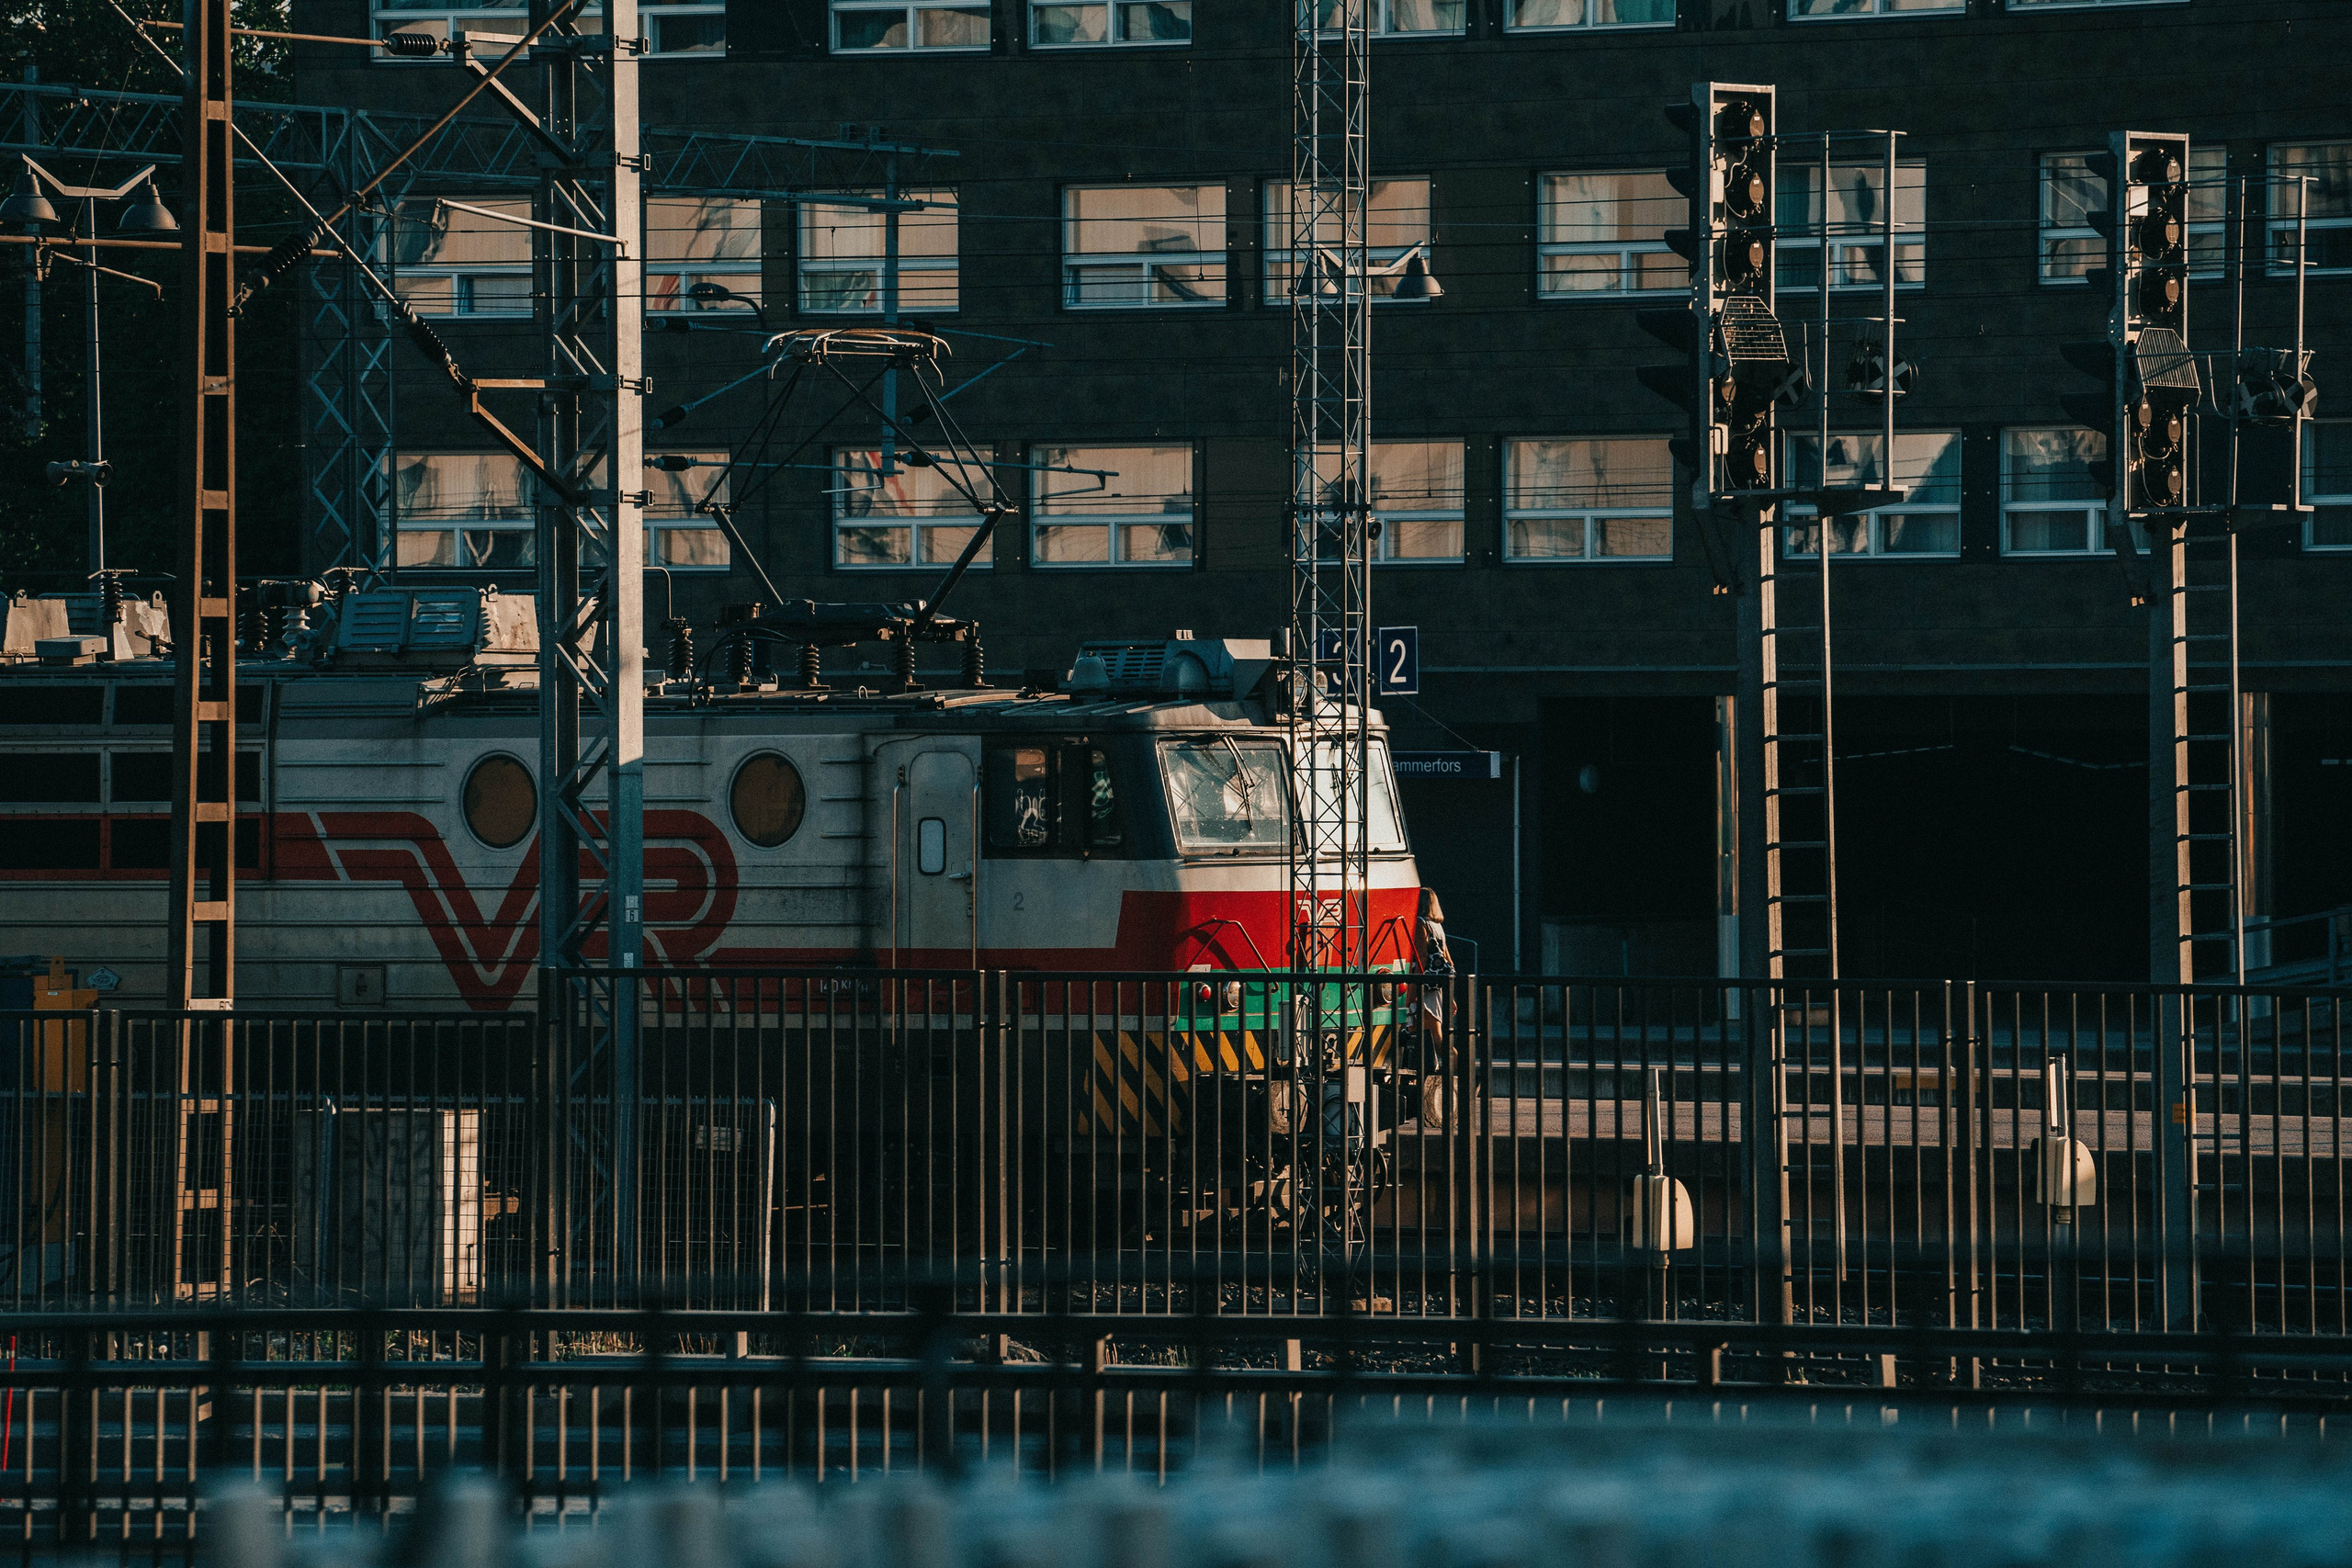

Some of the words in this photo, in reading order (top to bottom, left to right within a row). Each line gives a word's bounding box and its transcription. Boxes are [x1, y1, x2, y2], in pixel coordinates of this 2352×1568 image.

[1389, 638, 1408, 683] 2
[319, 809, 740, 1014] VR
[629, 909, 635, 922] 6
[1012, 891, 1024, 911] 2
